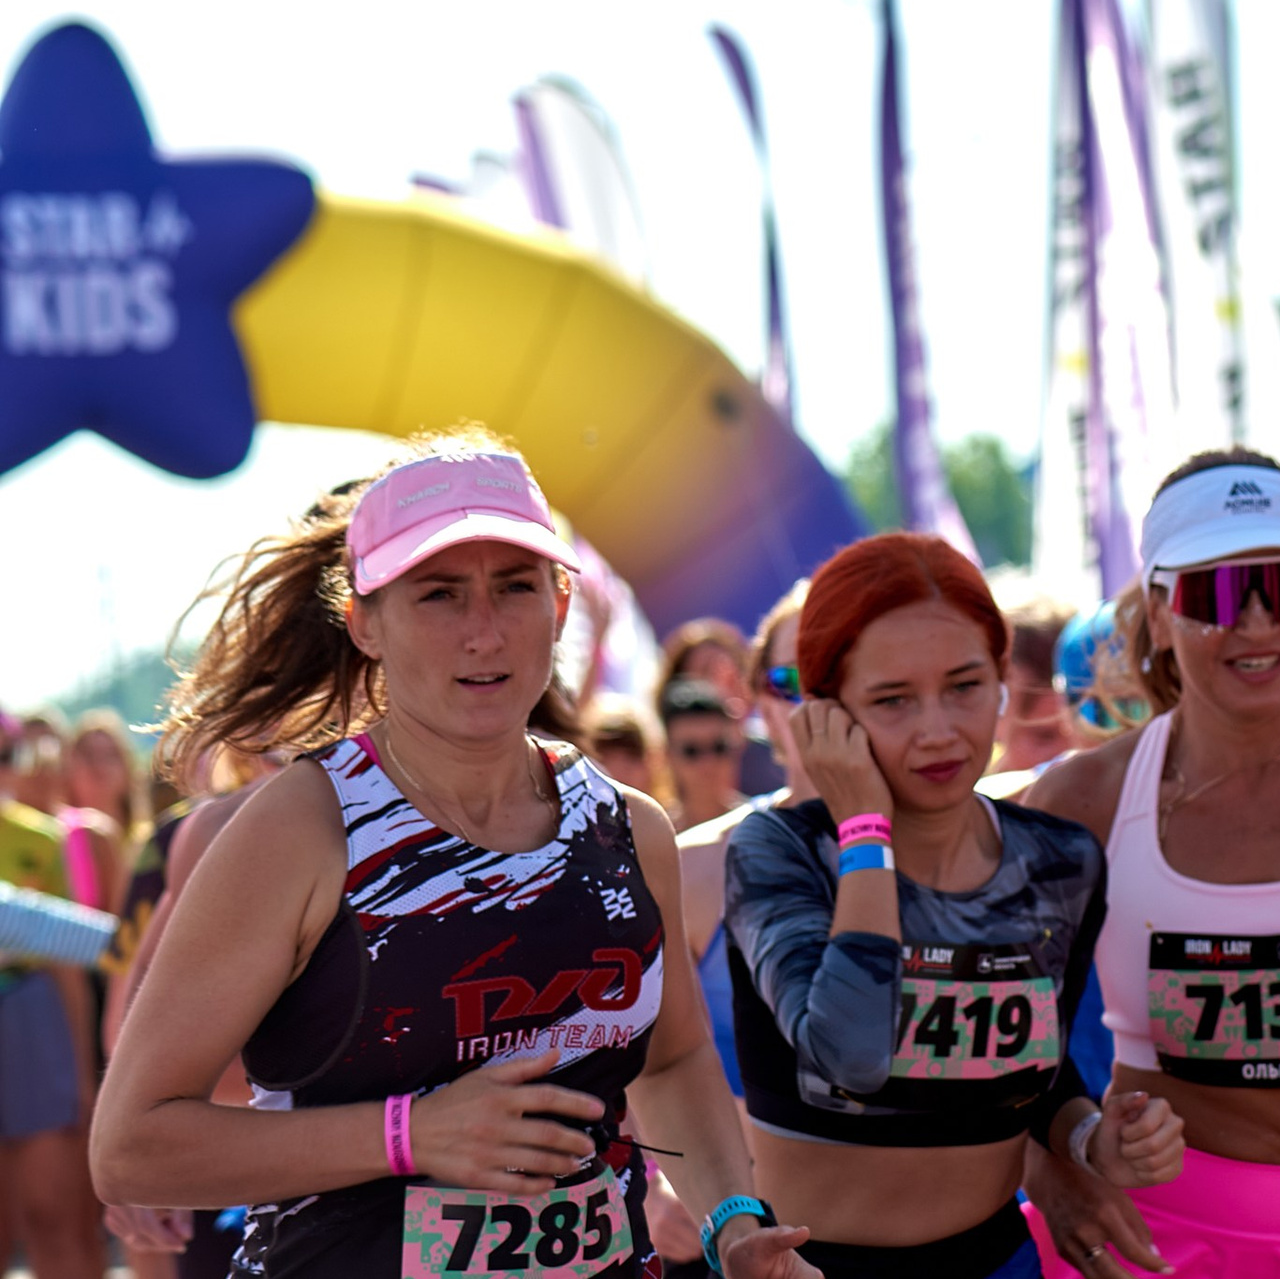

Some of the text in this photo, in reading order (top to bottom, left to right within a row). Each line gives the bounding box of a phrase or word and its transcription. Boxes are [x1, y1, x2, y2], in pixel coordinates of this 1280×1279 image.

[2, 192, 141, 260] STAR
[3, 265, 177, 357] KIDS
[923, 947, 955, 964] LADY
[1222, 940, 1252, 957] LADY
[455, 1023, 635, 1062] IRON TEAM
[441, 1188, 613, 1272] 7285
